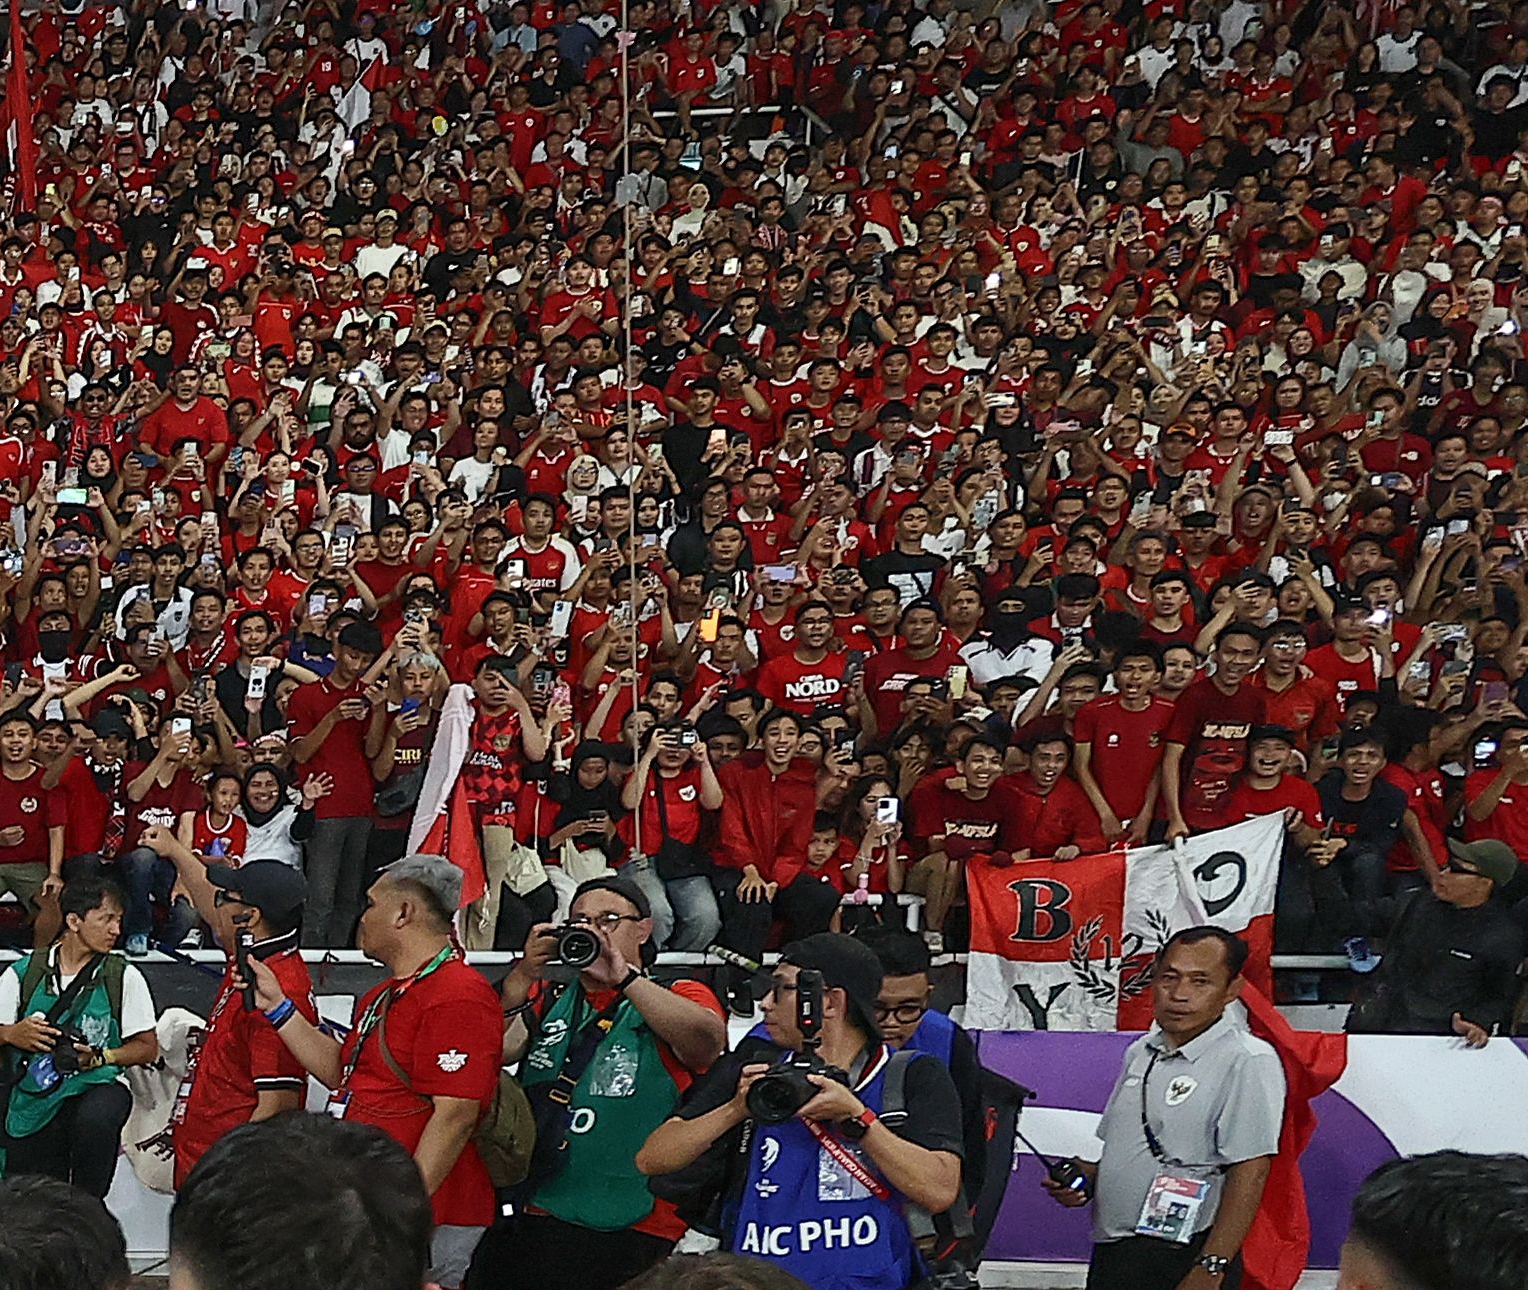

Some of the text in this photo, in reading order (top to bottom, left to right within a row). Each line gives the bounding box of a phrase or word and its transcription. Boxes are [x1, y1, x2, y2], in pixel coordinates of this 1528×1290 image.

[785, 678, 841, 699] NORD
[1007, 877, 1074, 944] B
[1099, 932, 1145, 973] 12
[1011, 981, 1071, 1030] Y
[741, 1214, 879, 1256] AIC PHO
